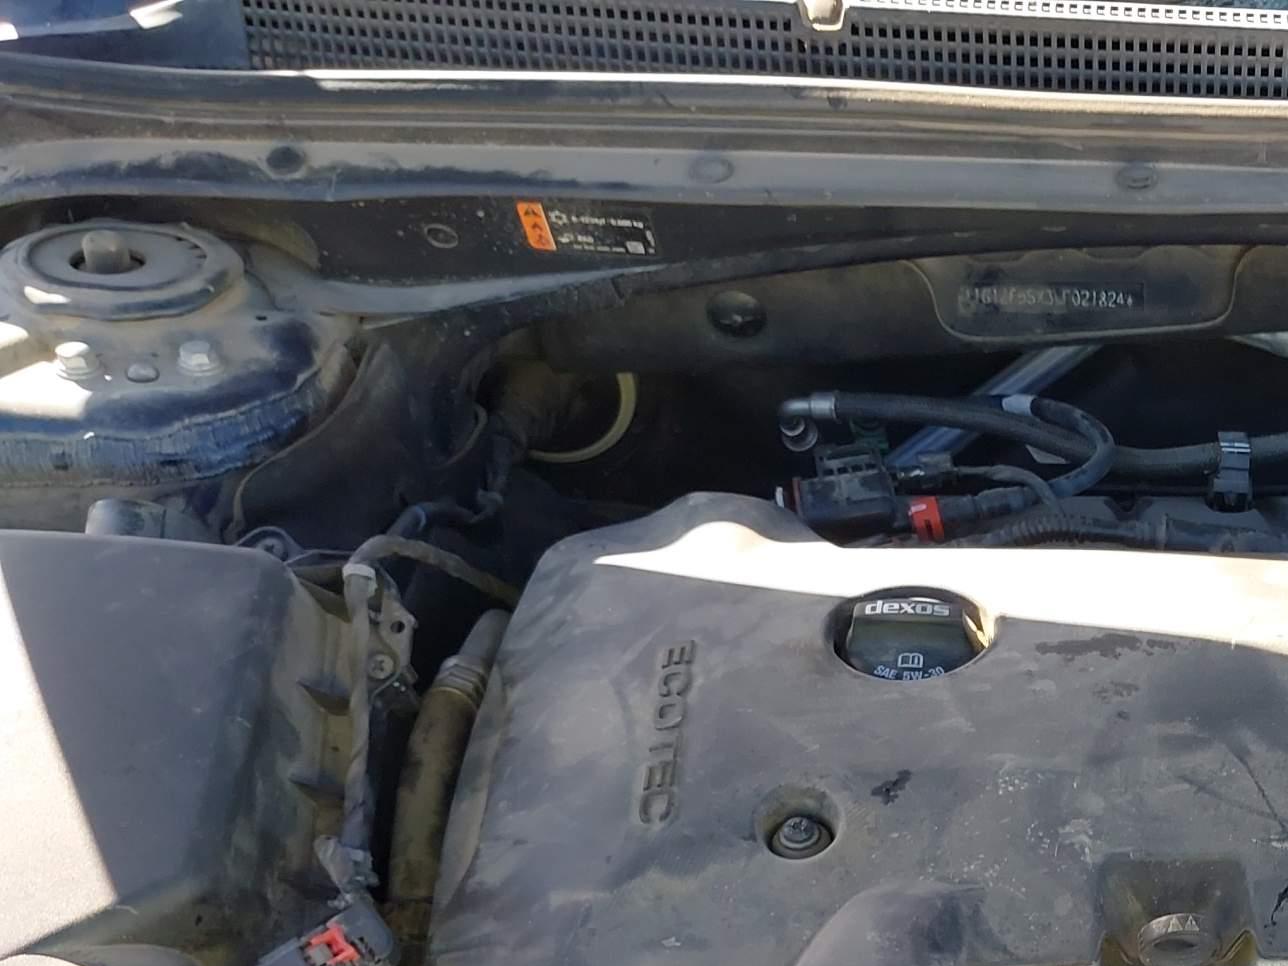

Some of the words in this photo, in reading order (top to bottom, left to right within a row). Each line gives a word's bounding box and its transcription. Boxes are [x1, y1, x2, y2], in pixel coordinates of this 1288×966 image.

[865, 600, 950, 616] dexos
[873, 665, 897, 679] SAE
[902, 666, 945, 680] 5W-30
[639, 639, 697, 824] ECOTEC
